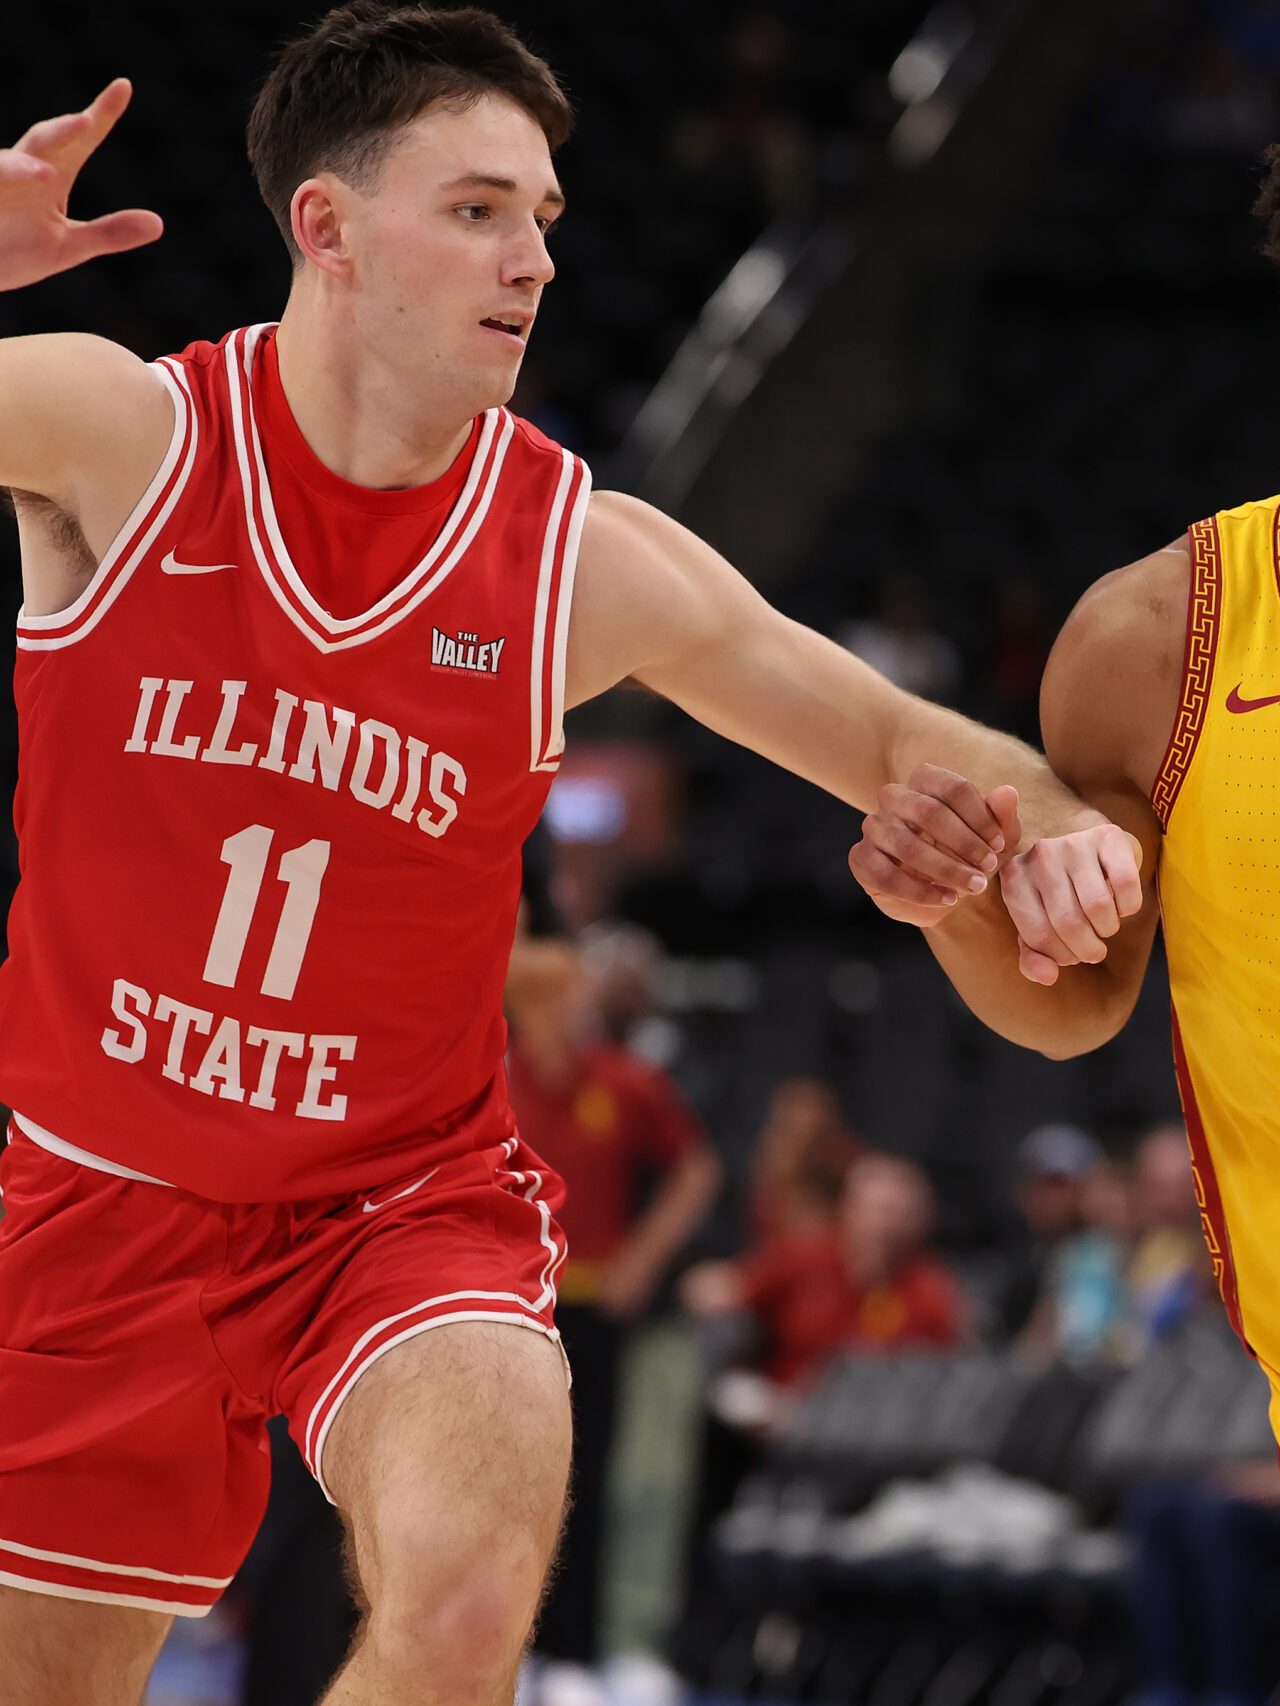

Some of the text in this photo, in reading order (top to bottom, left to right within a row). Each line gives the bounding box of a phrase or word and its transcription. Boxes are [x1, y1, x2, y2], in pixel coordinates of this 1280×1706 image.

[431, 626, 506, 674] VALLEY
[457, 631, 480, 643] THE
[124, 677, 467, 838] ILLINOIS
[203, 824, 331, 1000] 11
[100, 978, 358, 1121] STATE
